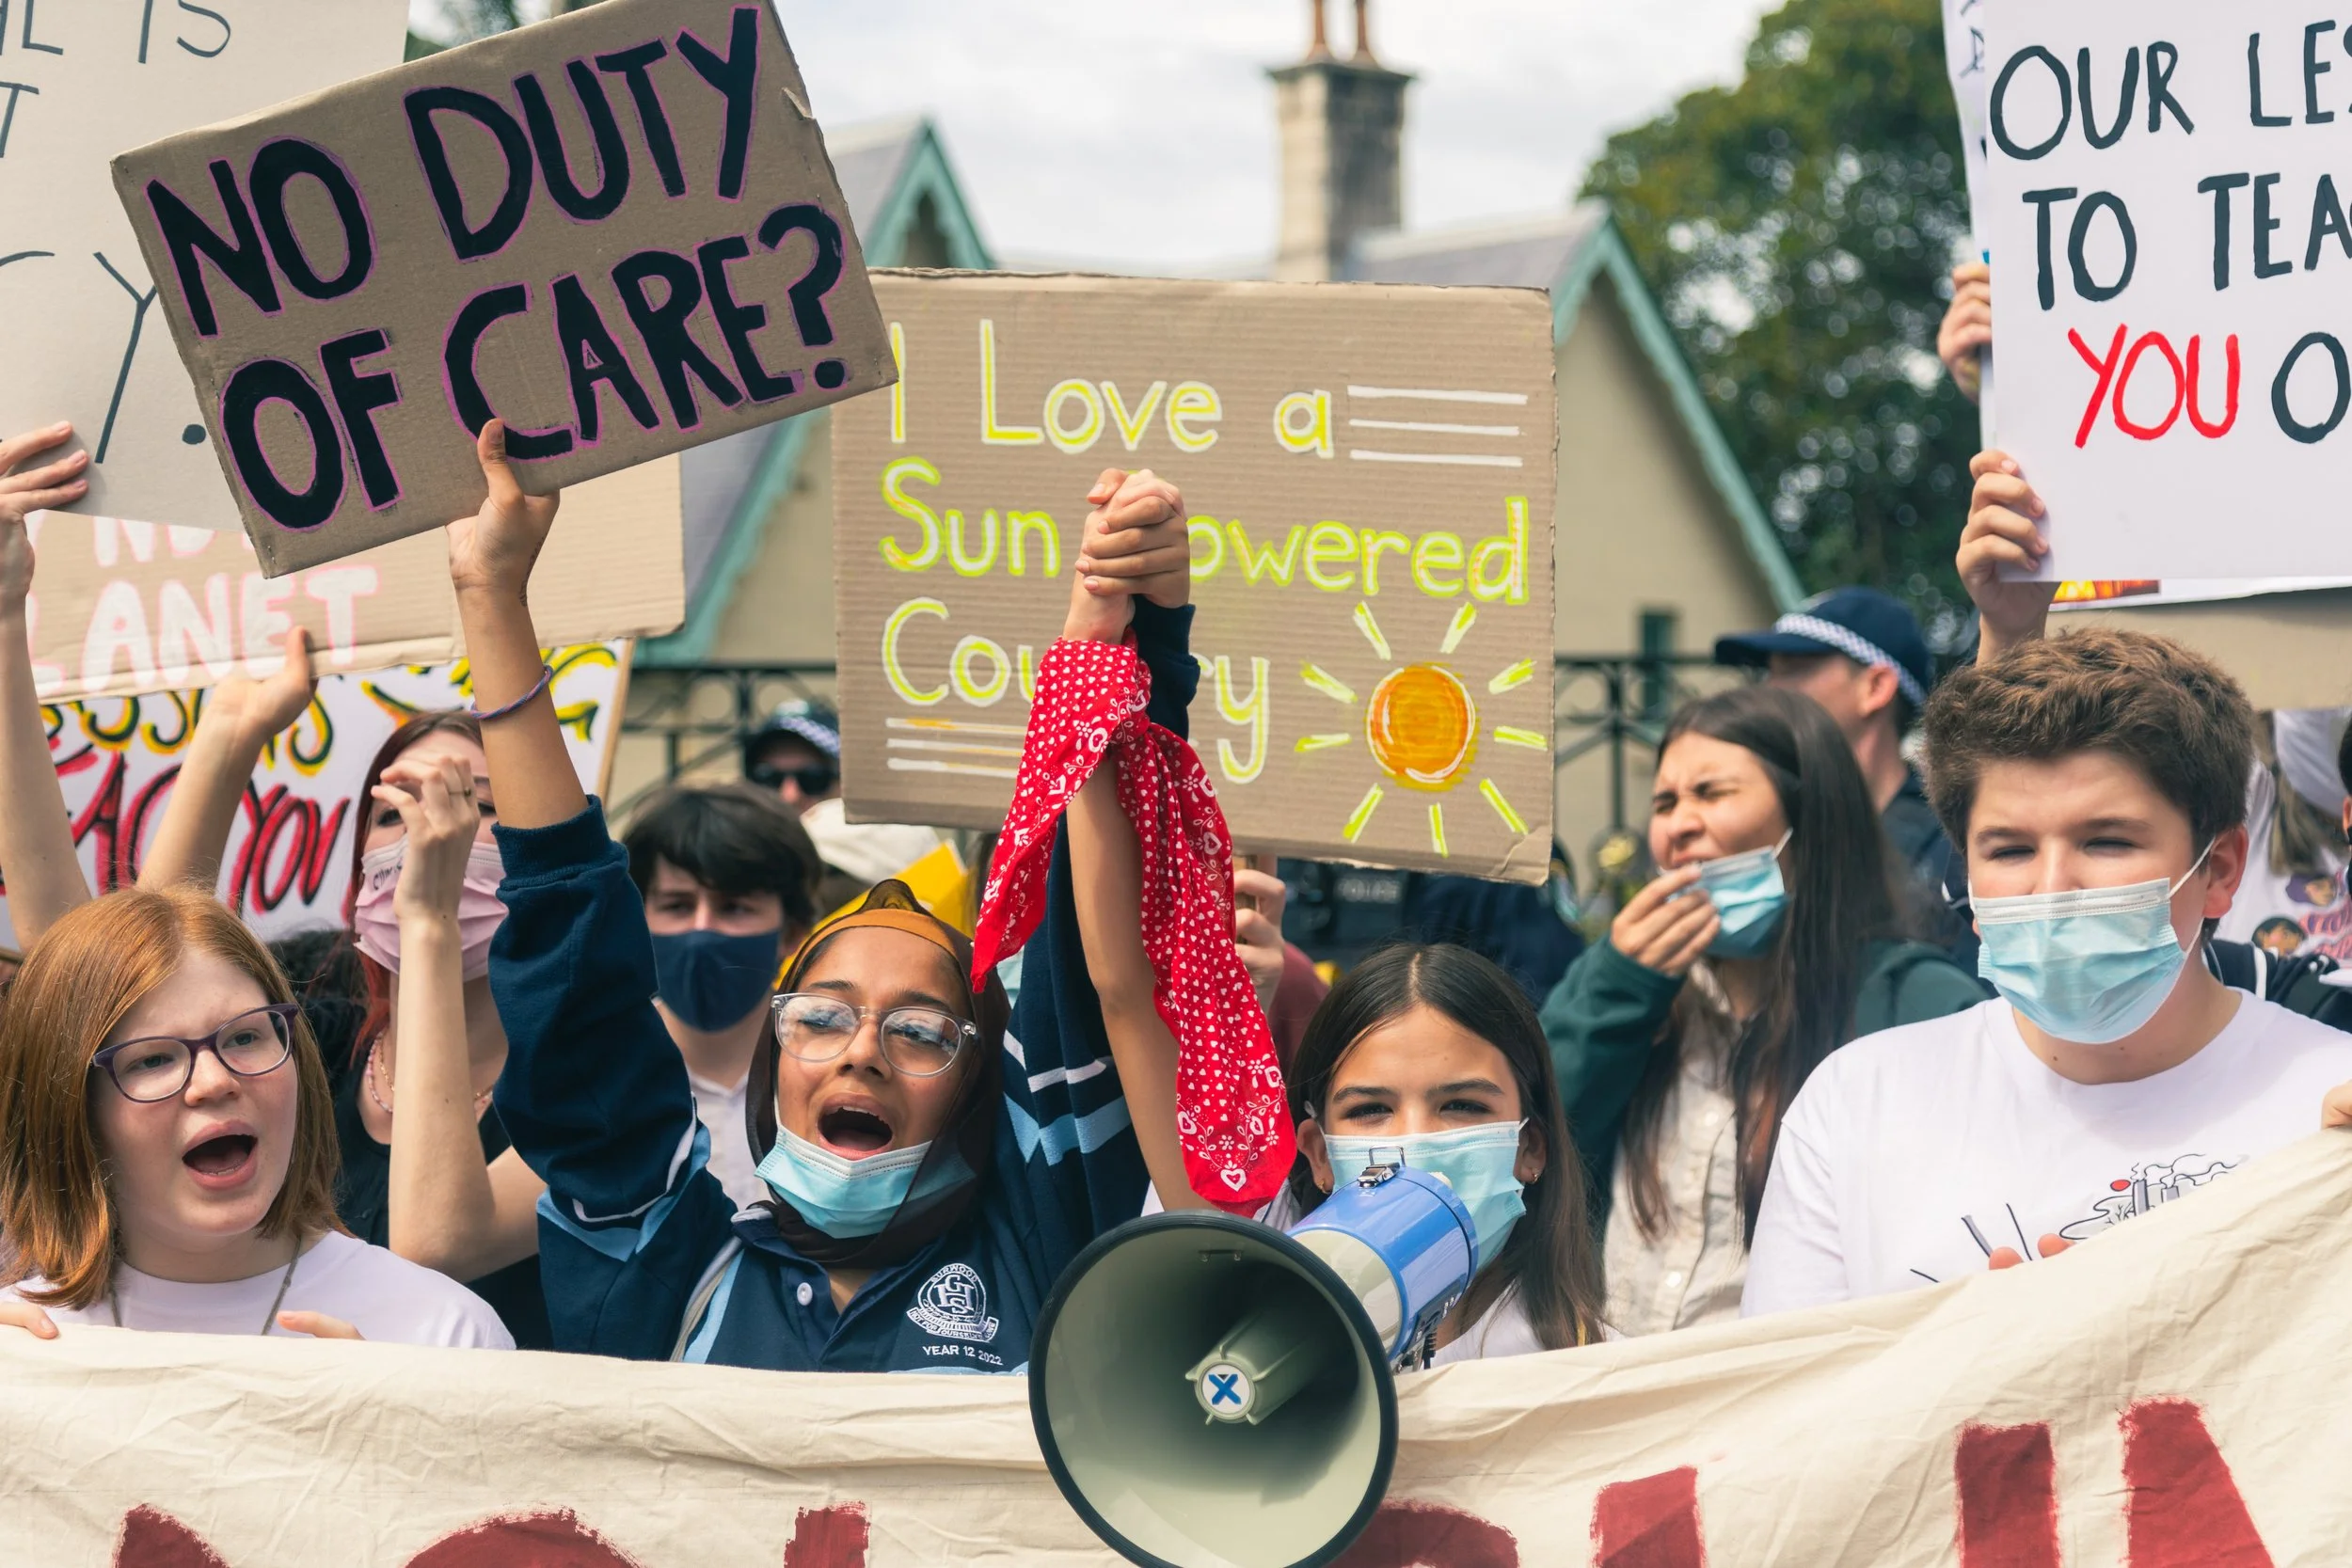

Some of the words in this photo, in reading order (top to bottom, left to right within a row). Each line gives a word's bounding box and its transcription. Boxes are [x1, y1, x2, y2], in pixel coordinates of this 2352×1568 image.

[1990, 40, 2194, 161] OUR
[146, 135, 376, 339] NO
[402, 4, 761, 262] DUTY
[2021, 186, 2137, 311] TO
[2198, 172, 2352, 292] TEA
[220, 327, 404, 533] OF
[442, 203, 846, 461] CARE?
[980, 319, 1222, 454] Love
[1273, 388, 1335, 459] a
[2068, 323, 2240, 449] YOU
[880, 456, 1060, 578] Sun
[1188, 496, 1529, 605] owered
[930, 1264, 977, 1283] BURWOOD
[922, 1344, 960, 1355] YEAR
[962, 1345, 976, 1357] 12
[977, 1350, 1004, 1366] 2022
